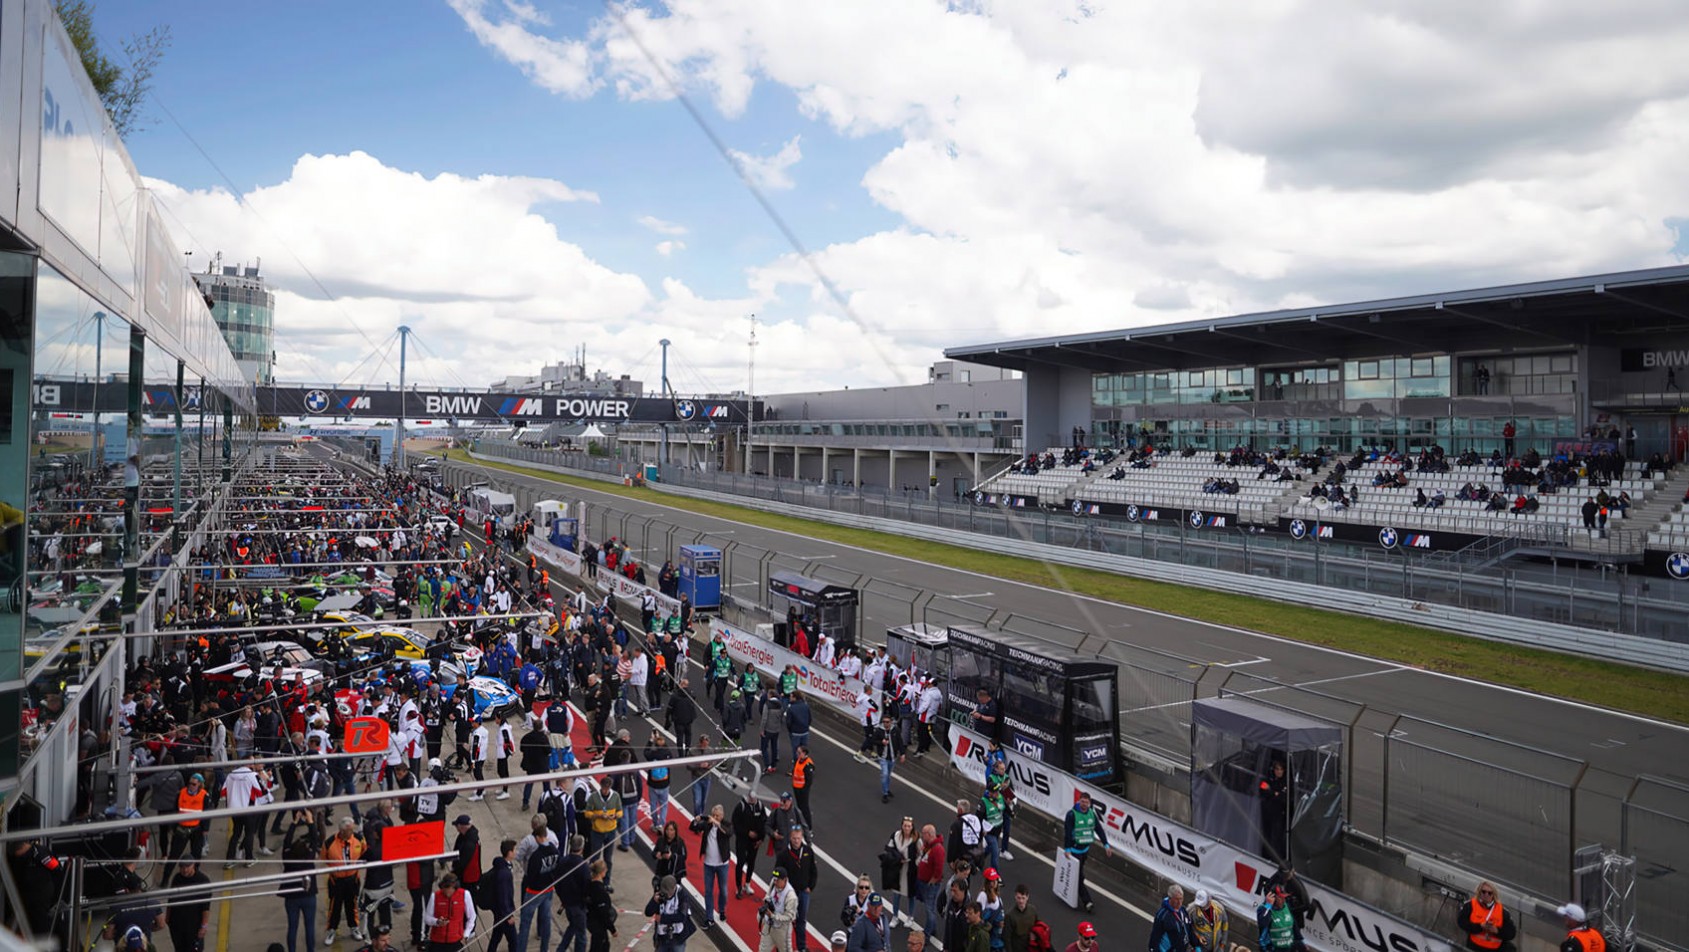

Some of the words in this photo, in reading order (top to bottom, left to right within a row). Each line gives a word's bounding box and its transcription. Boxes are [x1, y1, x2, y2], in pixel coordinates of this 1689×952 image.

[1643, 351, 1689, 367] BMW
[426, 396, 481, 414] BMW
[556, 399, 629, 417] POWER
[729, 633, 774, 666] TotalEnergies
[1016, 738, 1042, 760] YCM
[1084, 747, 1106, 759] YCM
